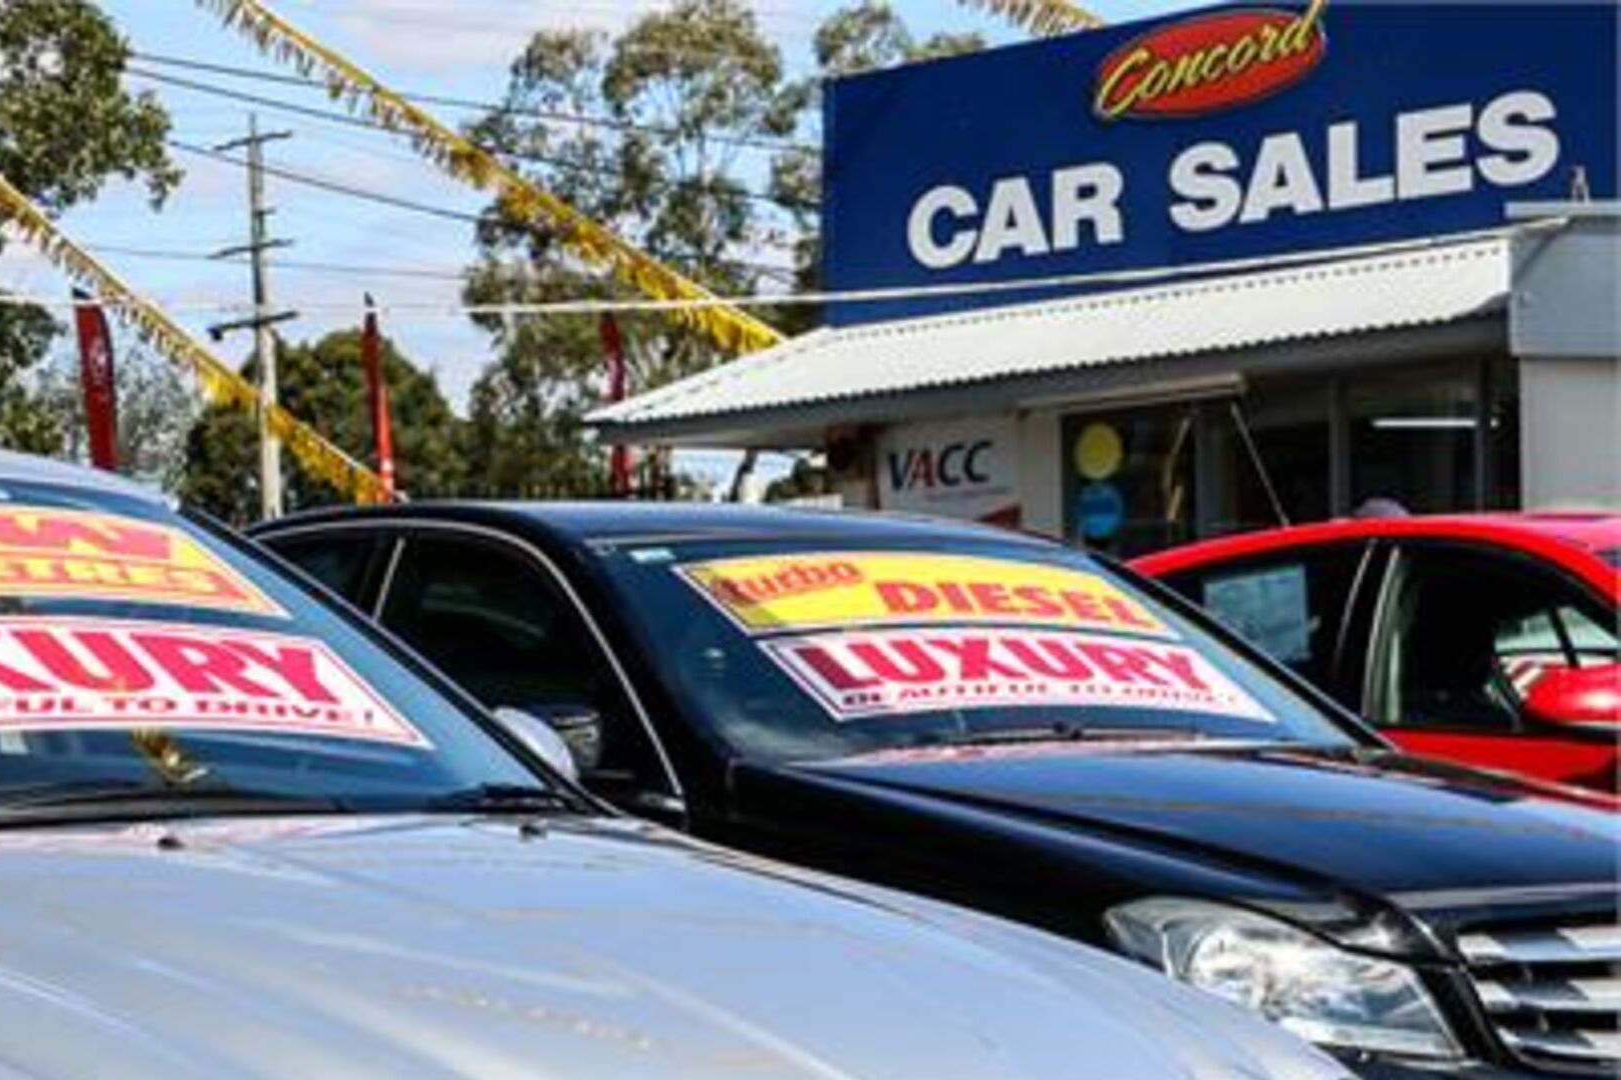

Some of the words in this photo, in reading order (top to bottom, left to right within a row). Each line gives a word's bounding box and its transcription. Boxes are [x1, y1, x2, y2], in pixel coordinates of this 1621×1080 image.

[1094, 1, 1328, 119] Concord
[907, 163, 1124, 269] CAR
[1169, 90, 1559, 231] SALES
[888, 440, 994, 490] VACC
[873, 580, 1155, 630] DIESEL
[791, 637, 1212, 693] LUXURY
[103, 697, 177, 711] TO
